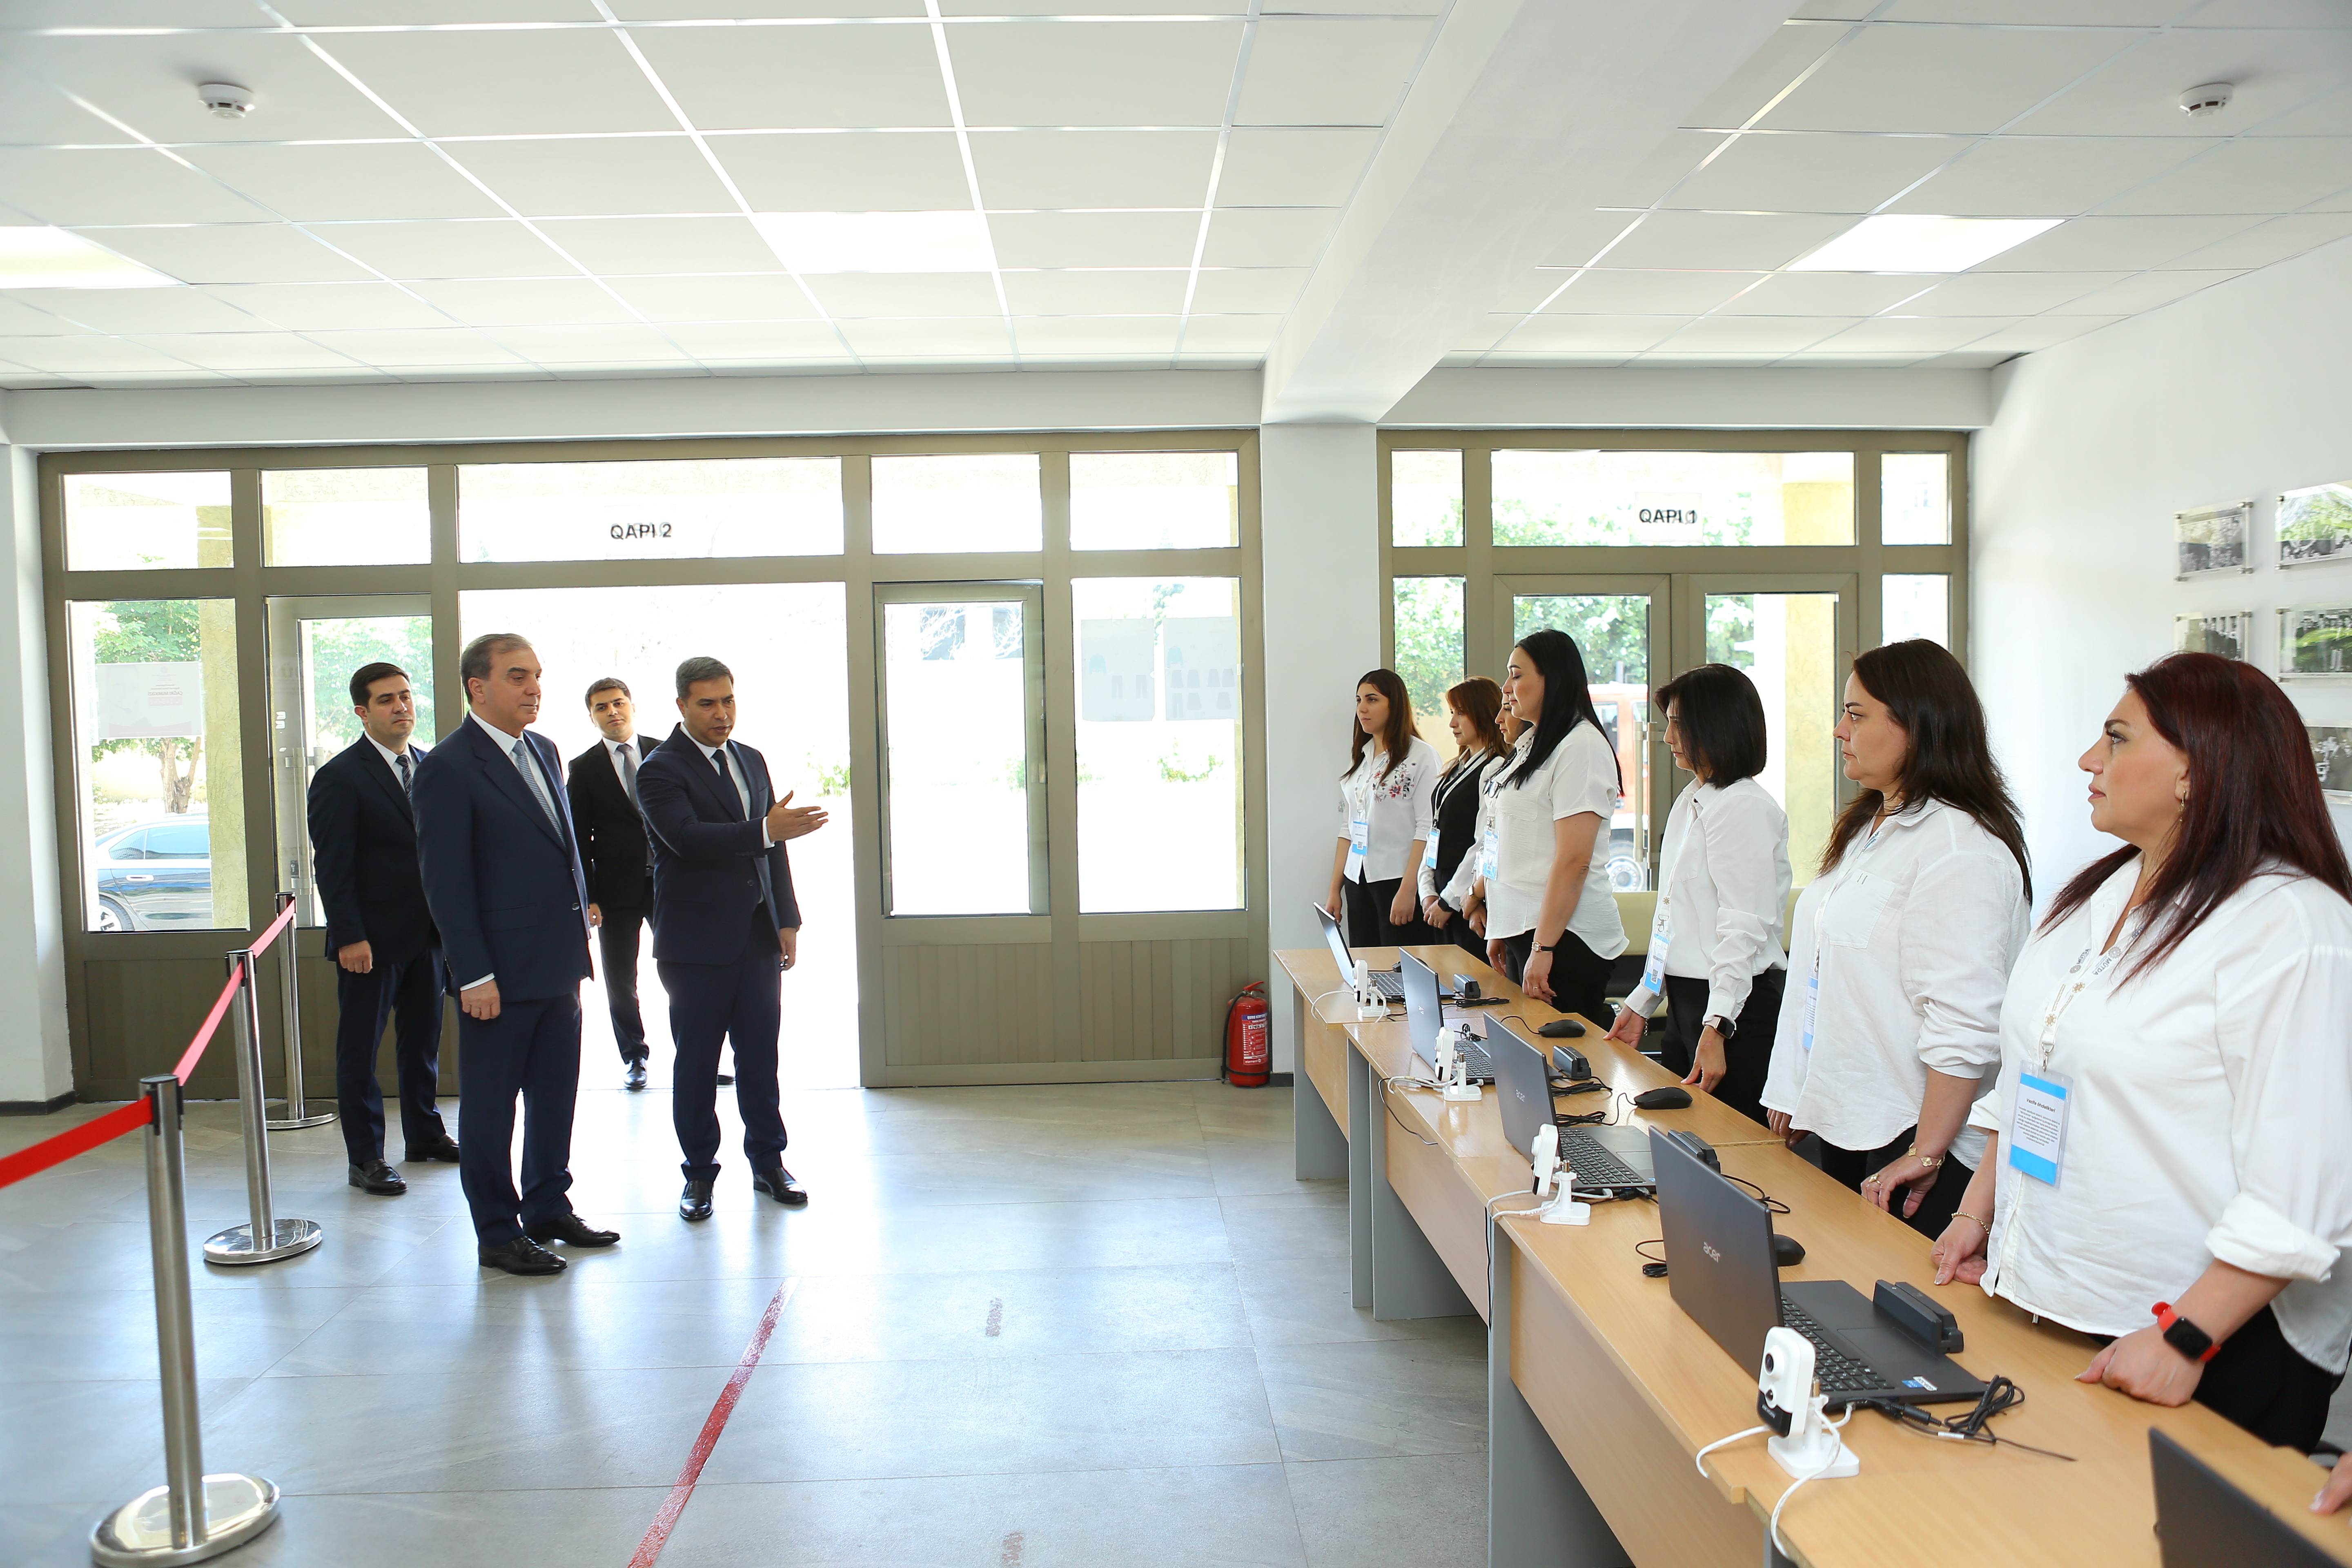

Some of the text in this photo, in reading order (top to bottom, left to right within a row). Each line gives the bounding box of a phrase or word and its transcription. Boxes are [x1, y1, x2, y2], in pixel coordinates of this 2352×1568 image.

[1639, 508, 1695, 523] QAPI 1
[610, 523, 672, 540] QAPI 2
[1516, 1089, 1525, 1102] acer
[1703, 1241, 1720, 1263] acer
